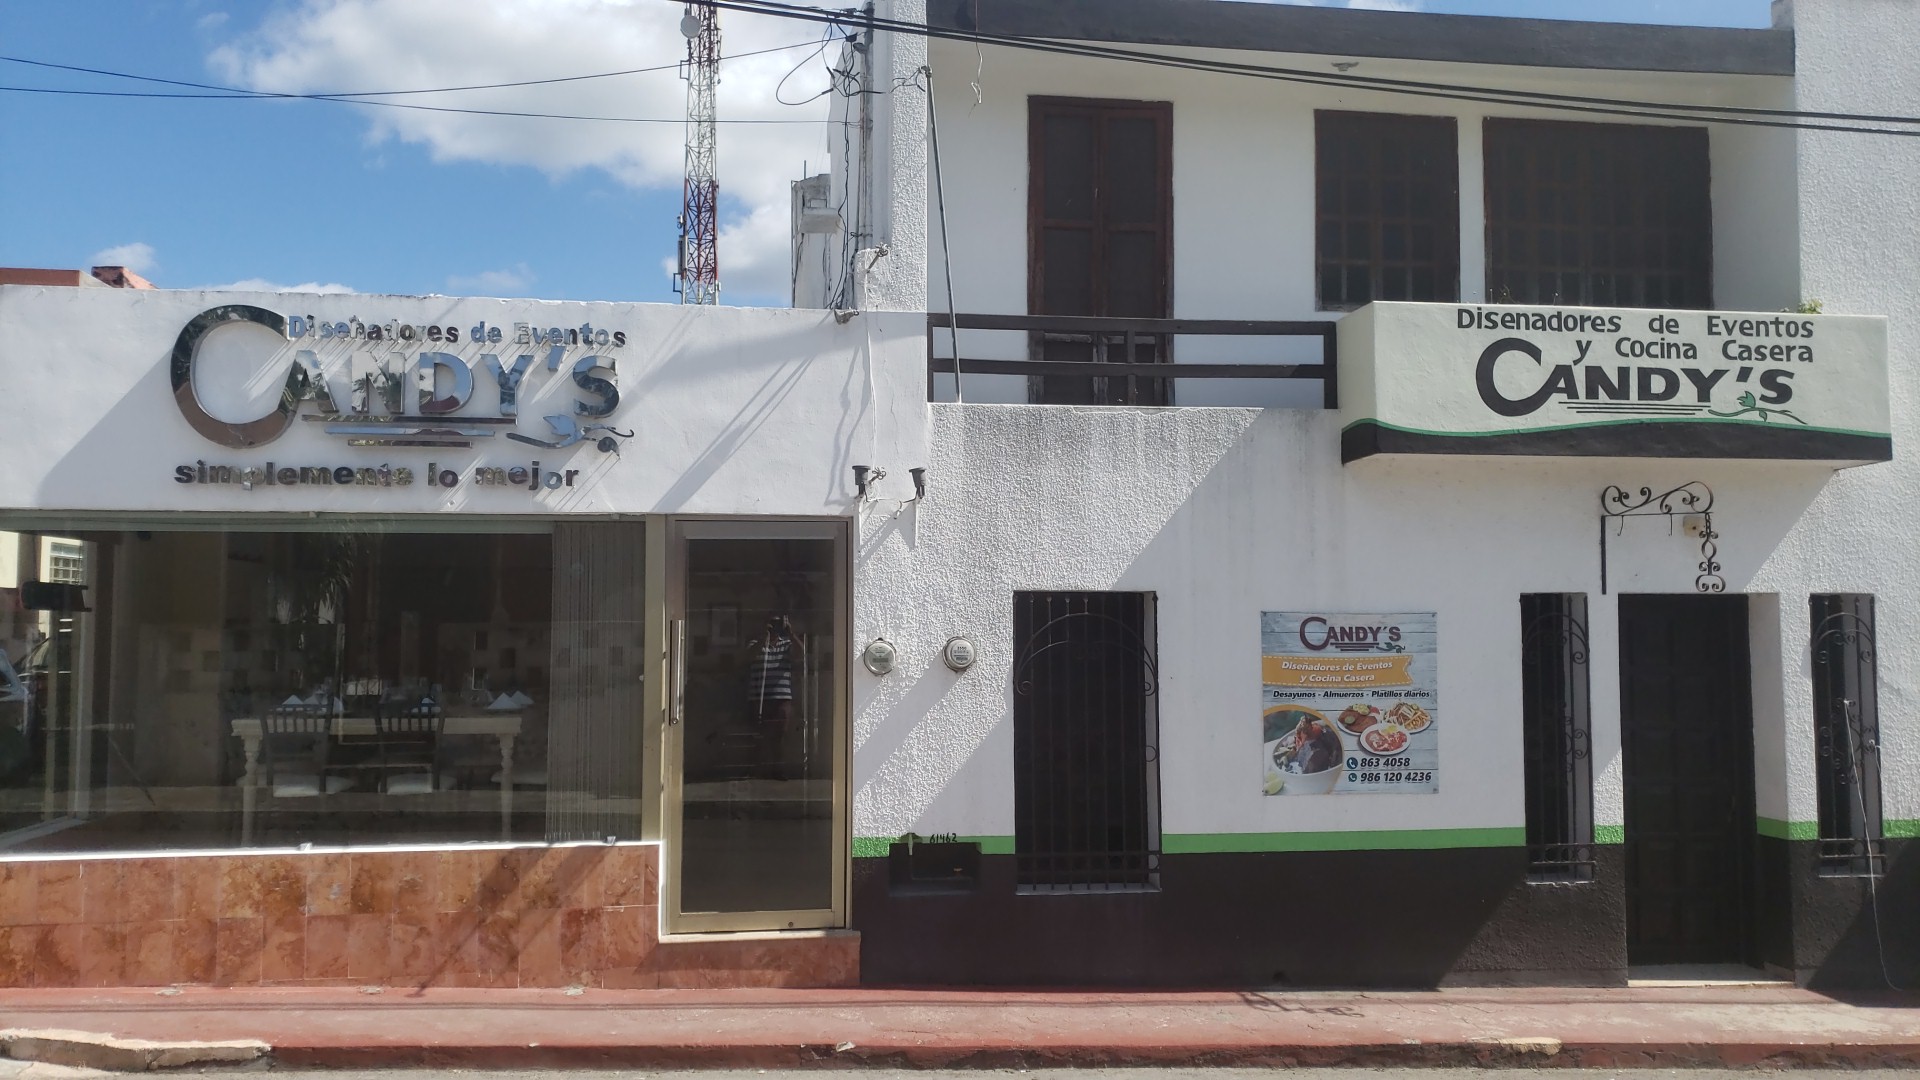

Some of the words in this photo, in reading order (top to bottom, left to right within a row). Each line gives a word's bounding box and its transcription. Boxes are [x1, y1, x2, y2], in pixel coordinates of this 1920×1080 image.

[1457, 308, 1622, 333] Disenadores
[1648, 314, 1680, 335] de
[1706, 315, 1814, 339] Eventos
[470, 320, 503, 344] de
[513, 322, 626, 348] Eventos
[1572, 339, 1593, 366] y
[1615, 336, 1698, 360] Cocina
[1721, 338, 1814, 363] Casera
[169, 303, 622, 449] CANDY'S
[1475, 337, 1795, 417] CANDY'S
[173, 459, 415, 491] simplemente
[427, 462, 460, 488] lo
[475, 460, 580, 491] mejor
[1281, 660, 1341, 672] Diseñadores
[1343, 662, 1355, 672] de
[1357, 660, 1393, 671] Eventos
[1300, 674, 1307, 684] y
[1309, 673, 1342, 683] Cocina
[1344, 673, 1375, 683] Casera
[1273, 690, 1316, 700] Desayunos
[1323, 690, 1364, 699] Almuerzos
[1371, 690, 1403, 699] Platillos
[1403, 690, 1430, 699] diarios
[1360, 757, 1380, 767] 863
[1383, 757, 1410, 767] 4058
[1360, 772, 1380, 782] 986
[1384, 772, 1402, 782] 120
[1405, 772, 1431, 782] 4236
[930, 832, 957, 843] 61462
